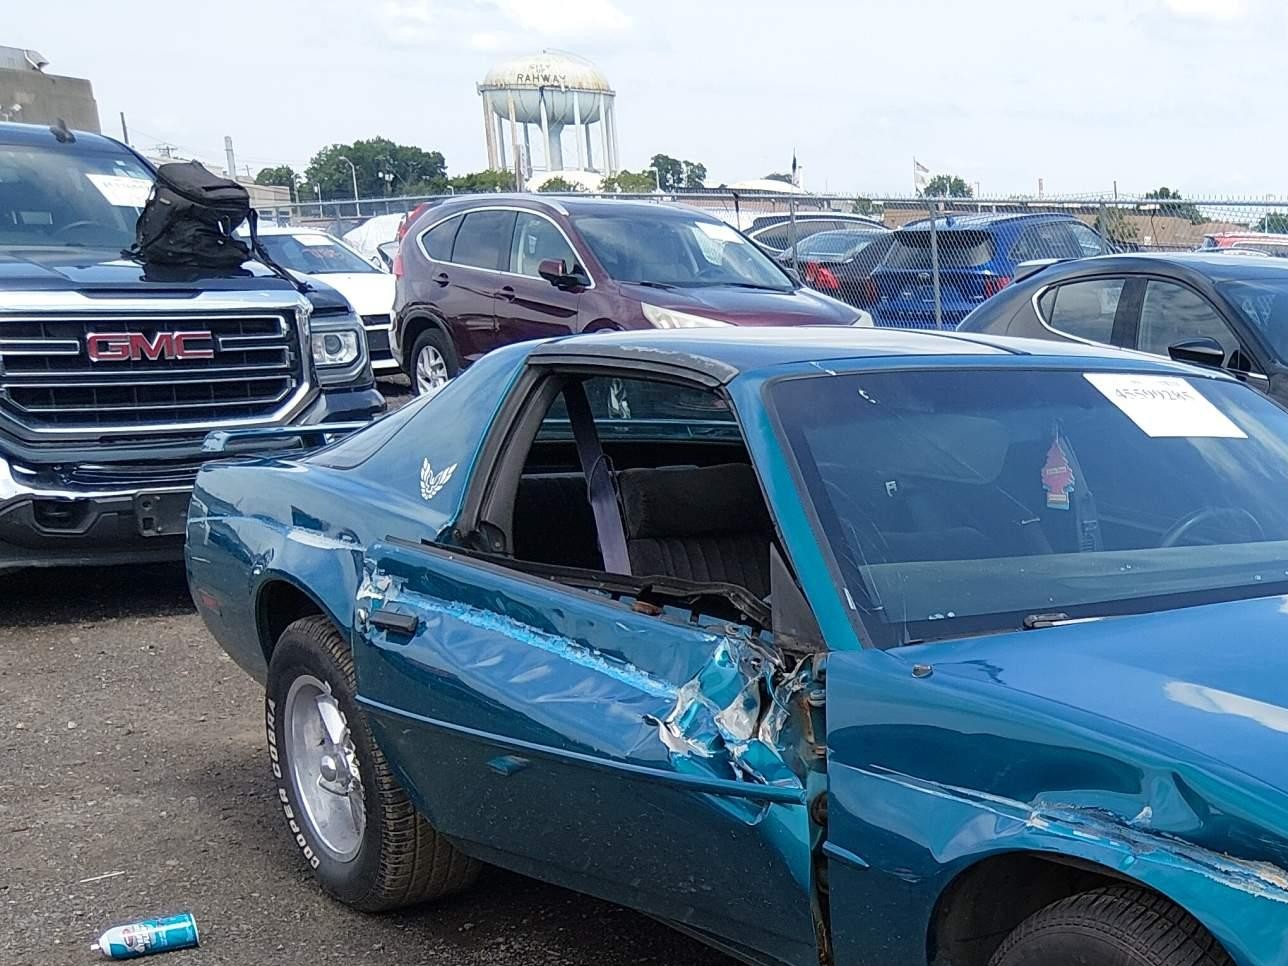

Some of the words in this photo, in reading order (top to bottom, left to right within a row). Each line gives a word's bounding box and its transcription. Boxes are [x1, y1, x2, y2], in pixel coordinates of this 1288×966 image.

[517, 73, 566, 83] RAHWAY
[86, 331, 214, 362] GMC
[267, 698, 283, 780] COBRA
[278, 787, 321, 870] COOPER
